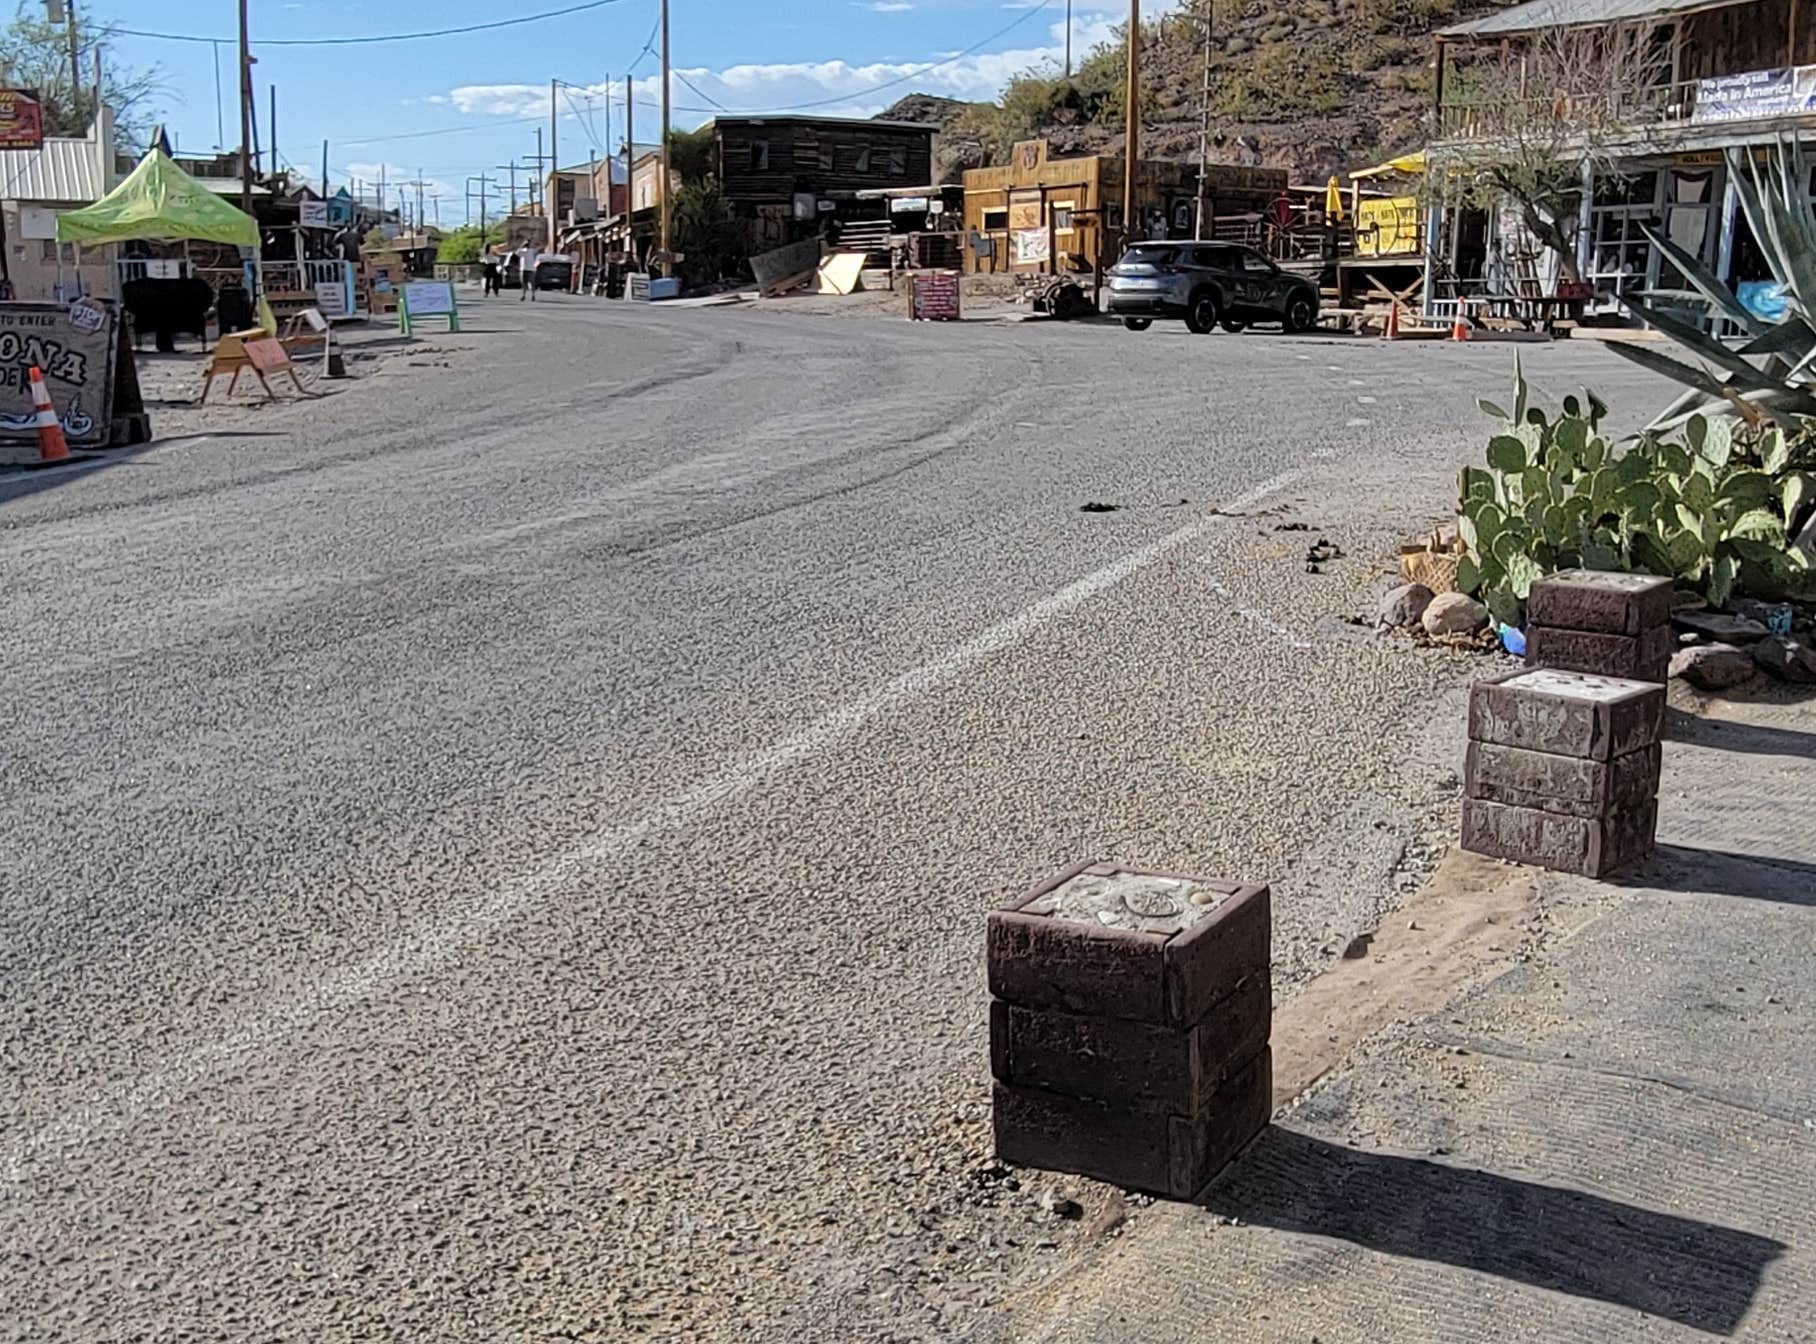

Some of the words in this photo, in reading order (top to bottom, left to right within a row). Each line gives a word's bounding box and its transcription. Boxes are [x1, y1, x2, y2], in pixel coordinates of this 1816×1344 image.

[1730, 89, 1742, 100] in
[1743, 84, 1792, 99] America
[1, 315, 14, 326] TO
[19, 315, 56, 327] ENTER
